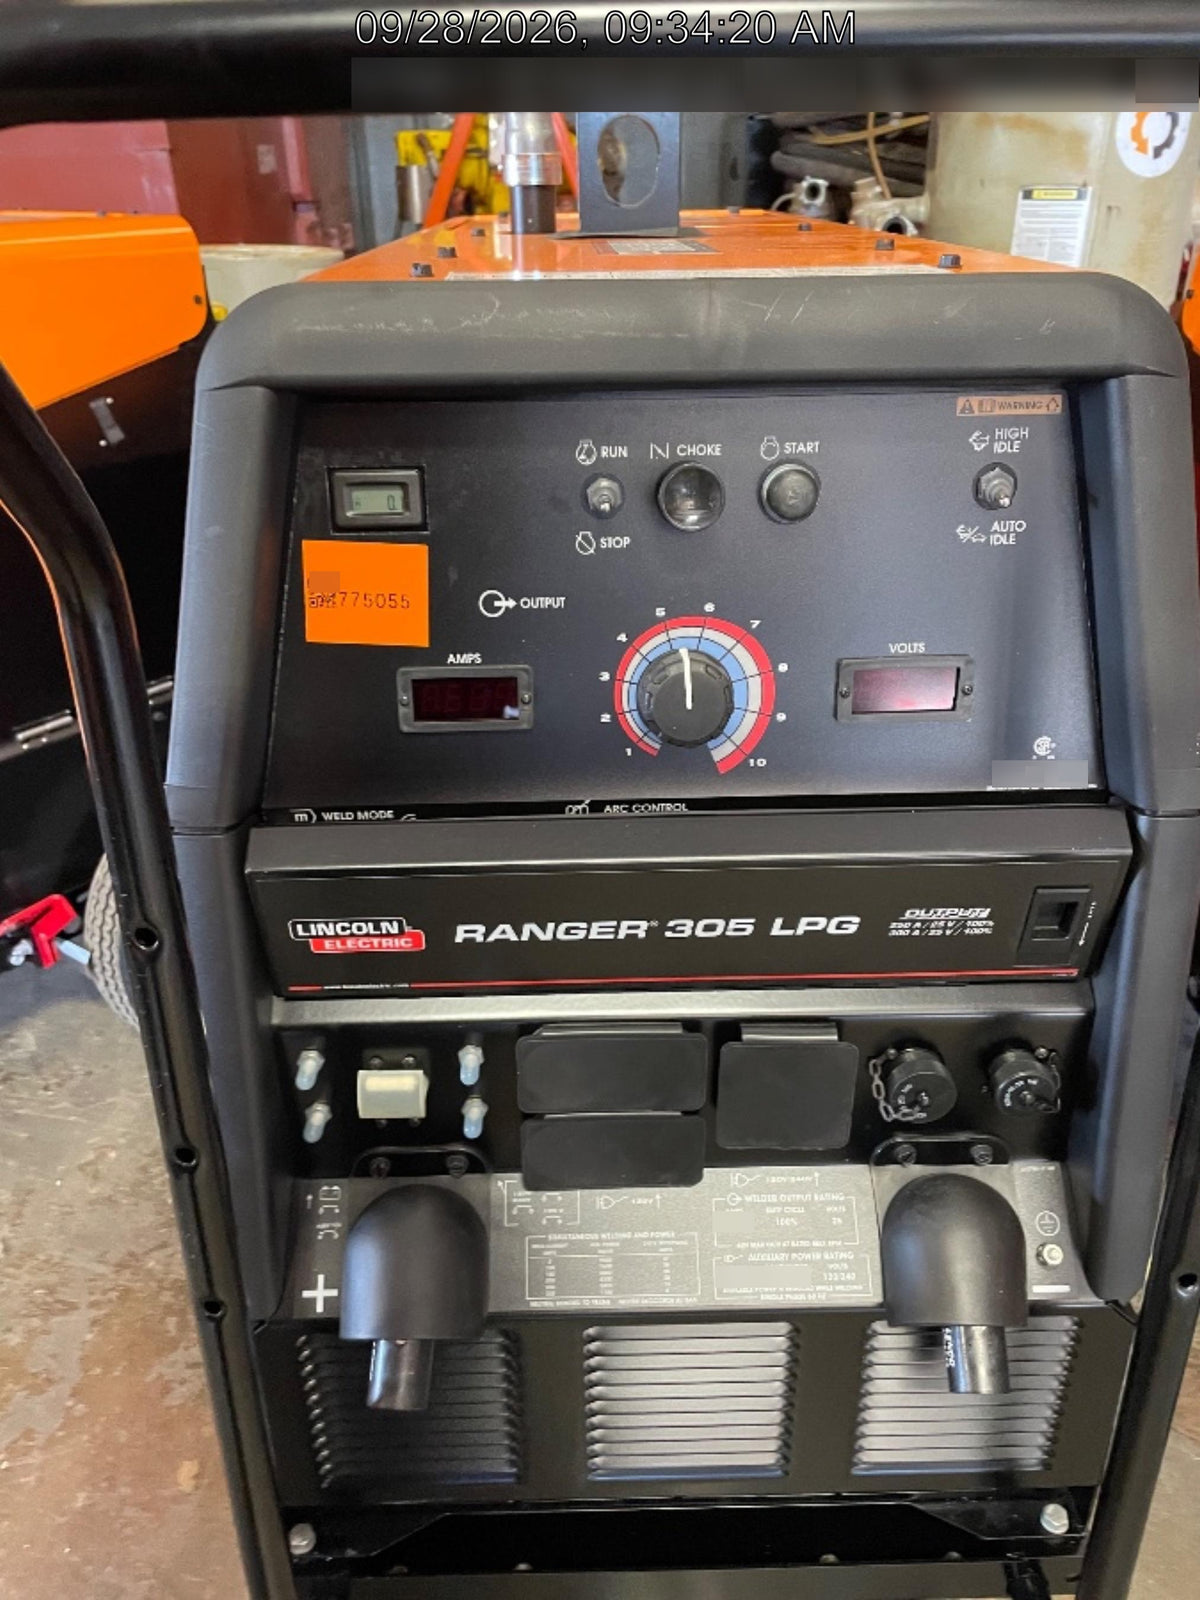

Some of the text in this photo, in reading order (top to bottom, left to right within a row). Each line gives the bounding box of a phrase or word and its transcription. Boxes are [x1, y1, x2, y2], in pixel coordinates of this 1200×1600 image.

[998, 400, 1042, 411] WARNING
[995, 427, 1029, 440] HIGH
[600, 446, 628, 458] RUN
[676, 444, 722, 456] CHOKE
[783, 441, 820, 454] START
[993, 441, 1021, 453] IDLE
[990, 520, 1027, 532] AUTO
[600, 536, 631, 549] STOP
[989, 533, 1016, 546] IDLE
[519, 596, 566, 609] OUTPUT
[703, 602, 716, 613] 6
[655, 607, 666, 617] 5
[749, 620, 762, 629] 7
[616, 632, 628, 642] 4
[888, 642, 926, 654] VOLTS
[446, 653, 482, 665] AMPS
[777, 662, 789, 673] 8
[598, 671, 611, 682] 3
[600, 713, 612, 723] 2
[775, 712, 787, 722] 9
[625, 747, 633, 757] 1
[748, 758, 767, 768] 10
[603, 802, 689, 814] ARC CONTROL
[321, 810, 395, 821] WELD MODE
[295, 919, 400, 937] LINCOLN
[664, 917, 755, 938] 305
[769, 916, 861, 937] LPG
[323, 936, 414, 951] ELECTRIC
[779, 1193, 813, 1203] OUTPUT
[813, 1192, 846, 1202] RATING
[823, 1251, 855, 1260] RATING
